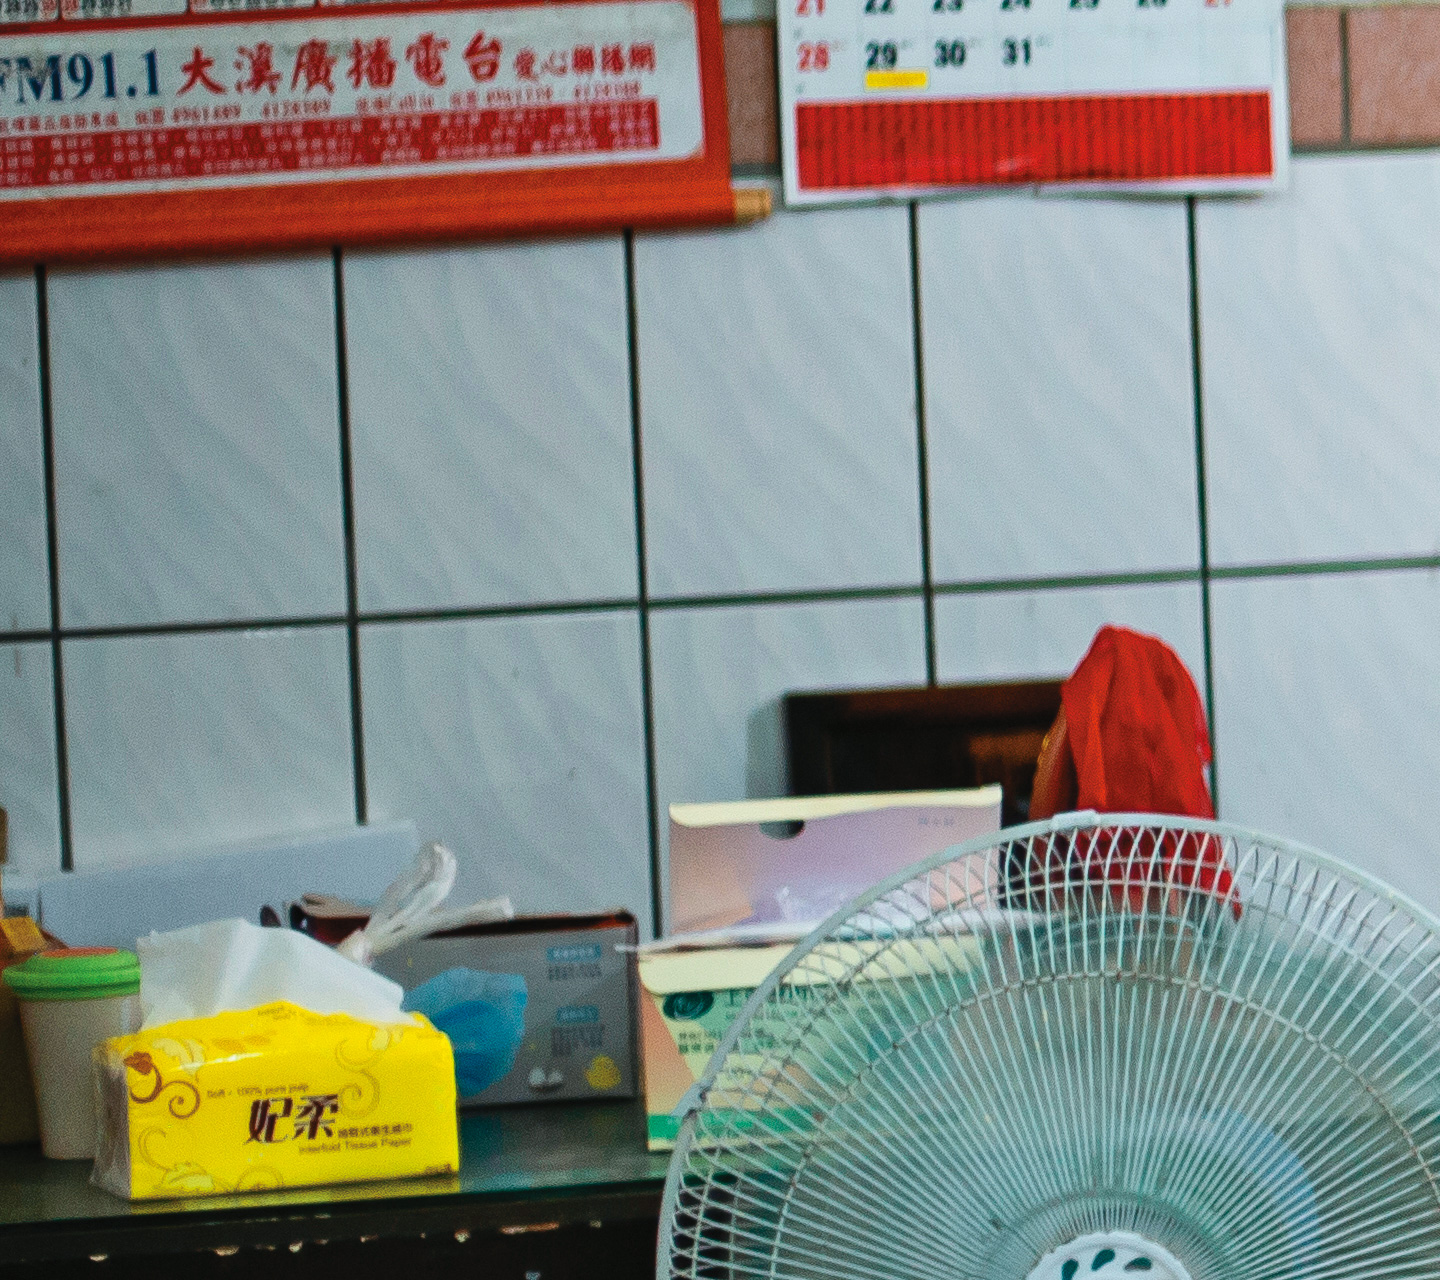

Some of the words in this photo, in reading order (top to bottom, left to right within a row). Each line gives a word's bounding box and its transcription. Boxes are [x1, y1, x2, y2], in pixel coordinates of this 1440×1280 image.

[0, 48, 160, 104] M91.1
[798, 41, 829, 71] 28
[865, 39, 898, 69] 29
[934, 38, 966, 68] 30
[1001, 37, 1032, 66] 31
[243, 1093, 340, 1145] 妃柔
